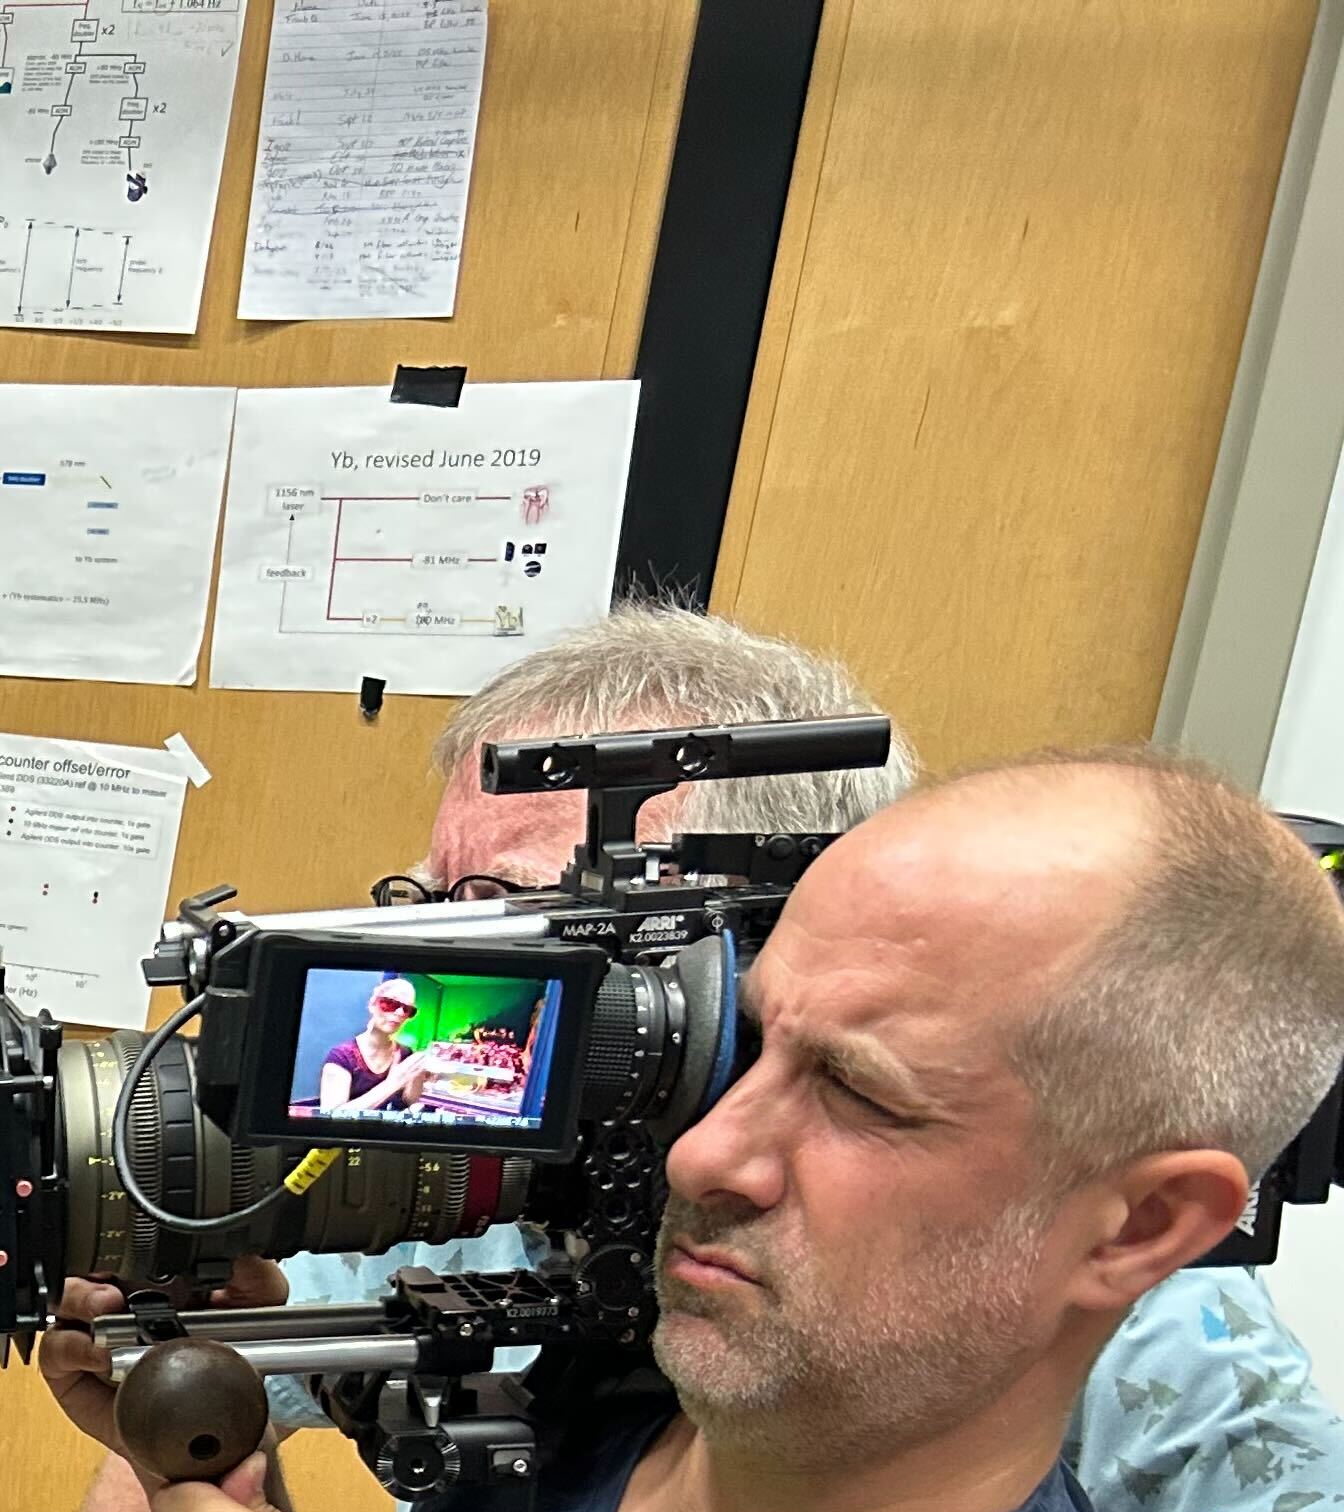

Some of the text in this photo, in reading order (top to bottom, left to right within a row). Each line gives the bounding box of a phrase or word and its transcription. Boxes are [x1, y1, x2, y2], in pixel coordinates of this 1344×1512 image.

[331, 448, 542, 470] Yb, revised June 2019
[299, 489, 314, 498] nm
[423, 492, 472, 503] Don't care
[282, 502, 305, 512] laser
[438, 556, 460, 565] MHz
[266, 568, 306, 579] feedback
[53, 758, 131, 779] offset/error
[87, 781, 97, 792] @
[100, 783, 110, 791] 10
[111, 783, 130, 794] MHz
[132, 786, 140, 794] to
[637, 914, 685, 932] ARRI
[562, 922, 617, 937] MAP-2A
[18, 987, 38, 999] (Hz)
[348, 1156, 361, 1167] 22
